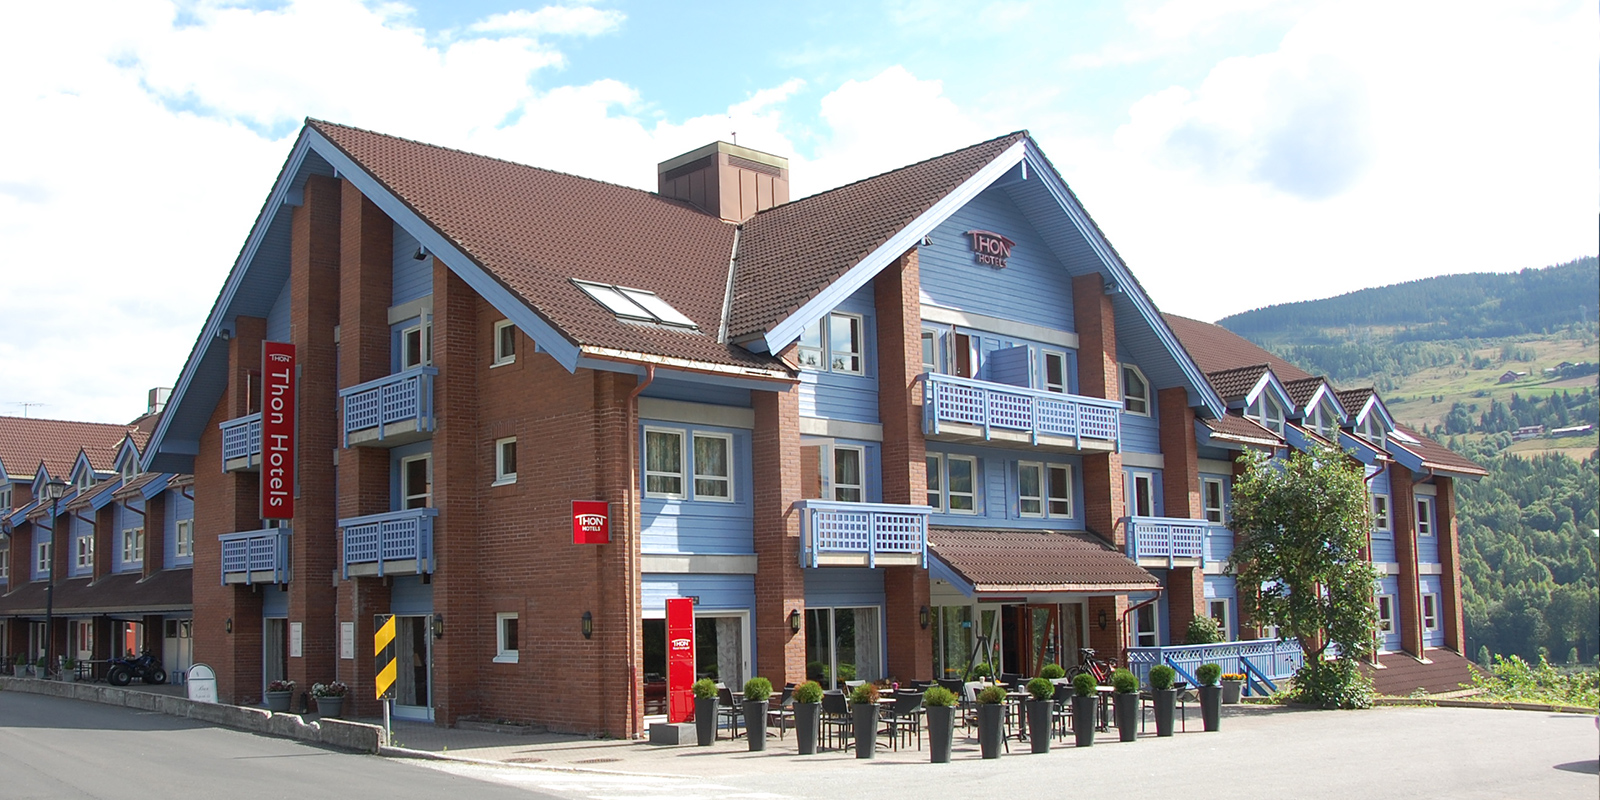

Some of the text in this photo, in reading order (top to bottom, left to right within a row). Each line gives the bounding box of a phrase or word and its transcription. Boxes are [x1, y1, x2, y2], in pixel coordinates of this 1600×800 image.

[967, 229, 1016, 258] THON
[977, 253, 1007, 268] HOTELS
[269, 353, 292, 362] THON
[270, 368, 290, 506] Thon Hotels
[575, 513, 607, 526] THON
[671, 638, 691, 646] THON
